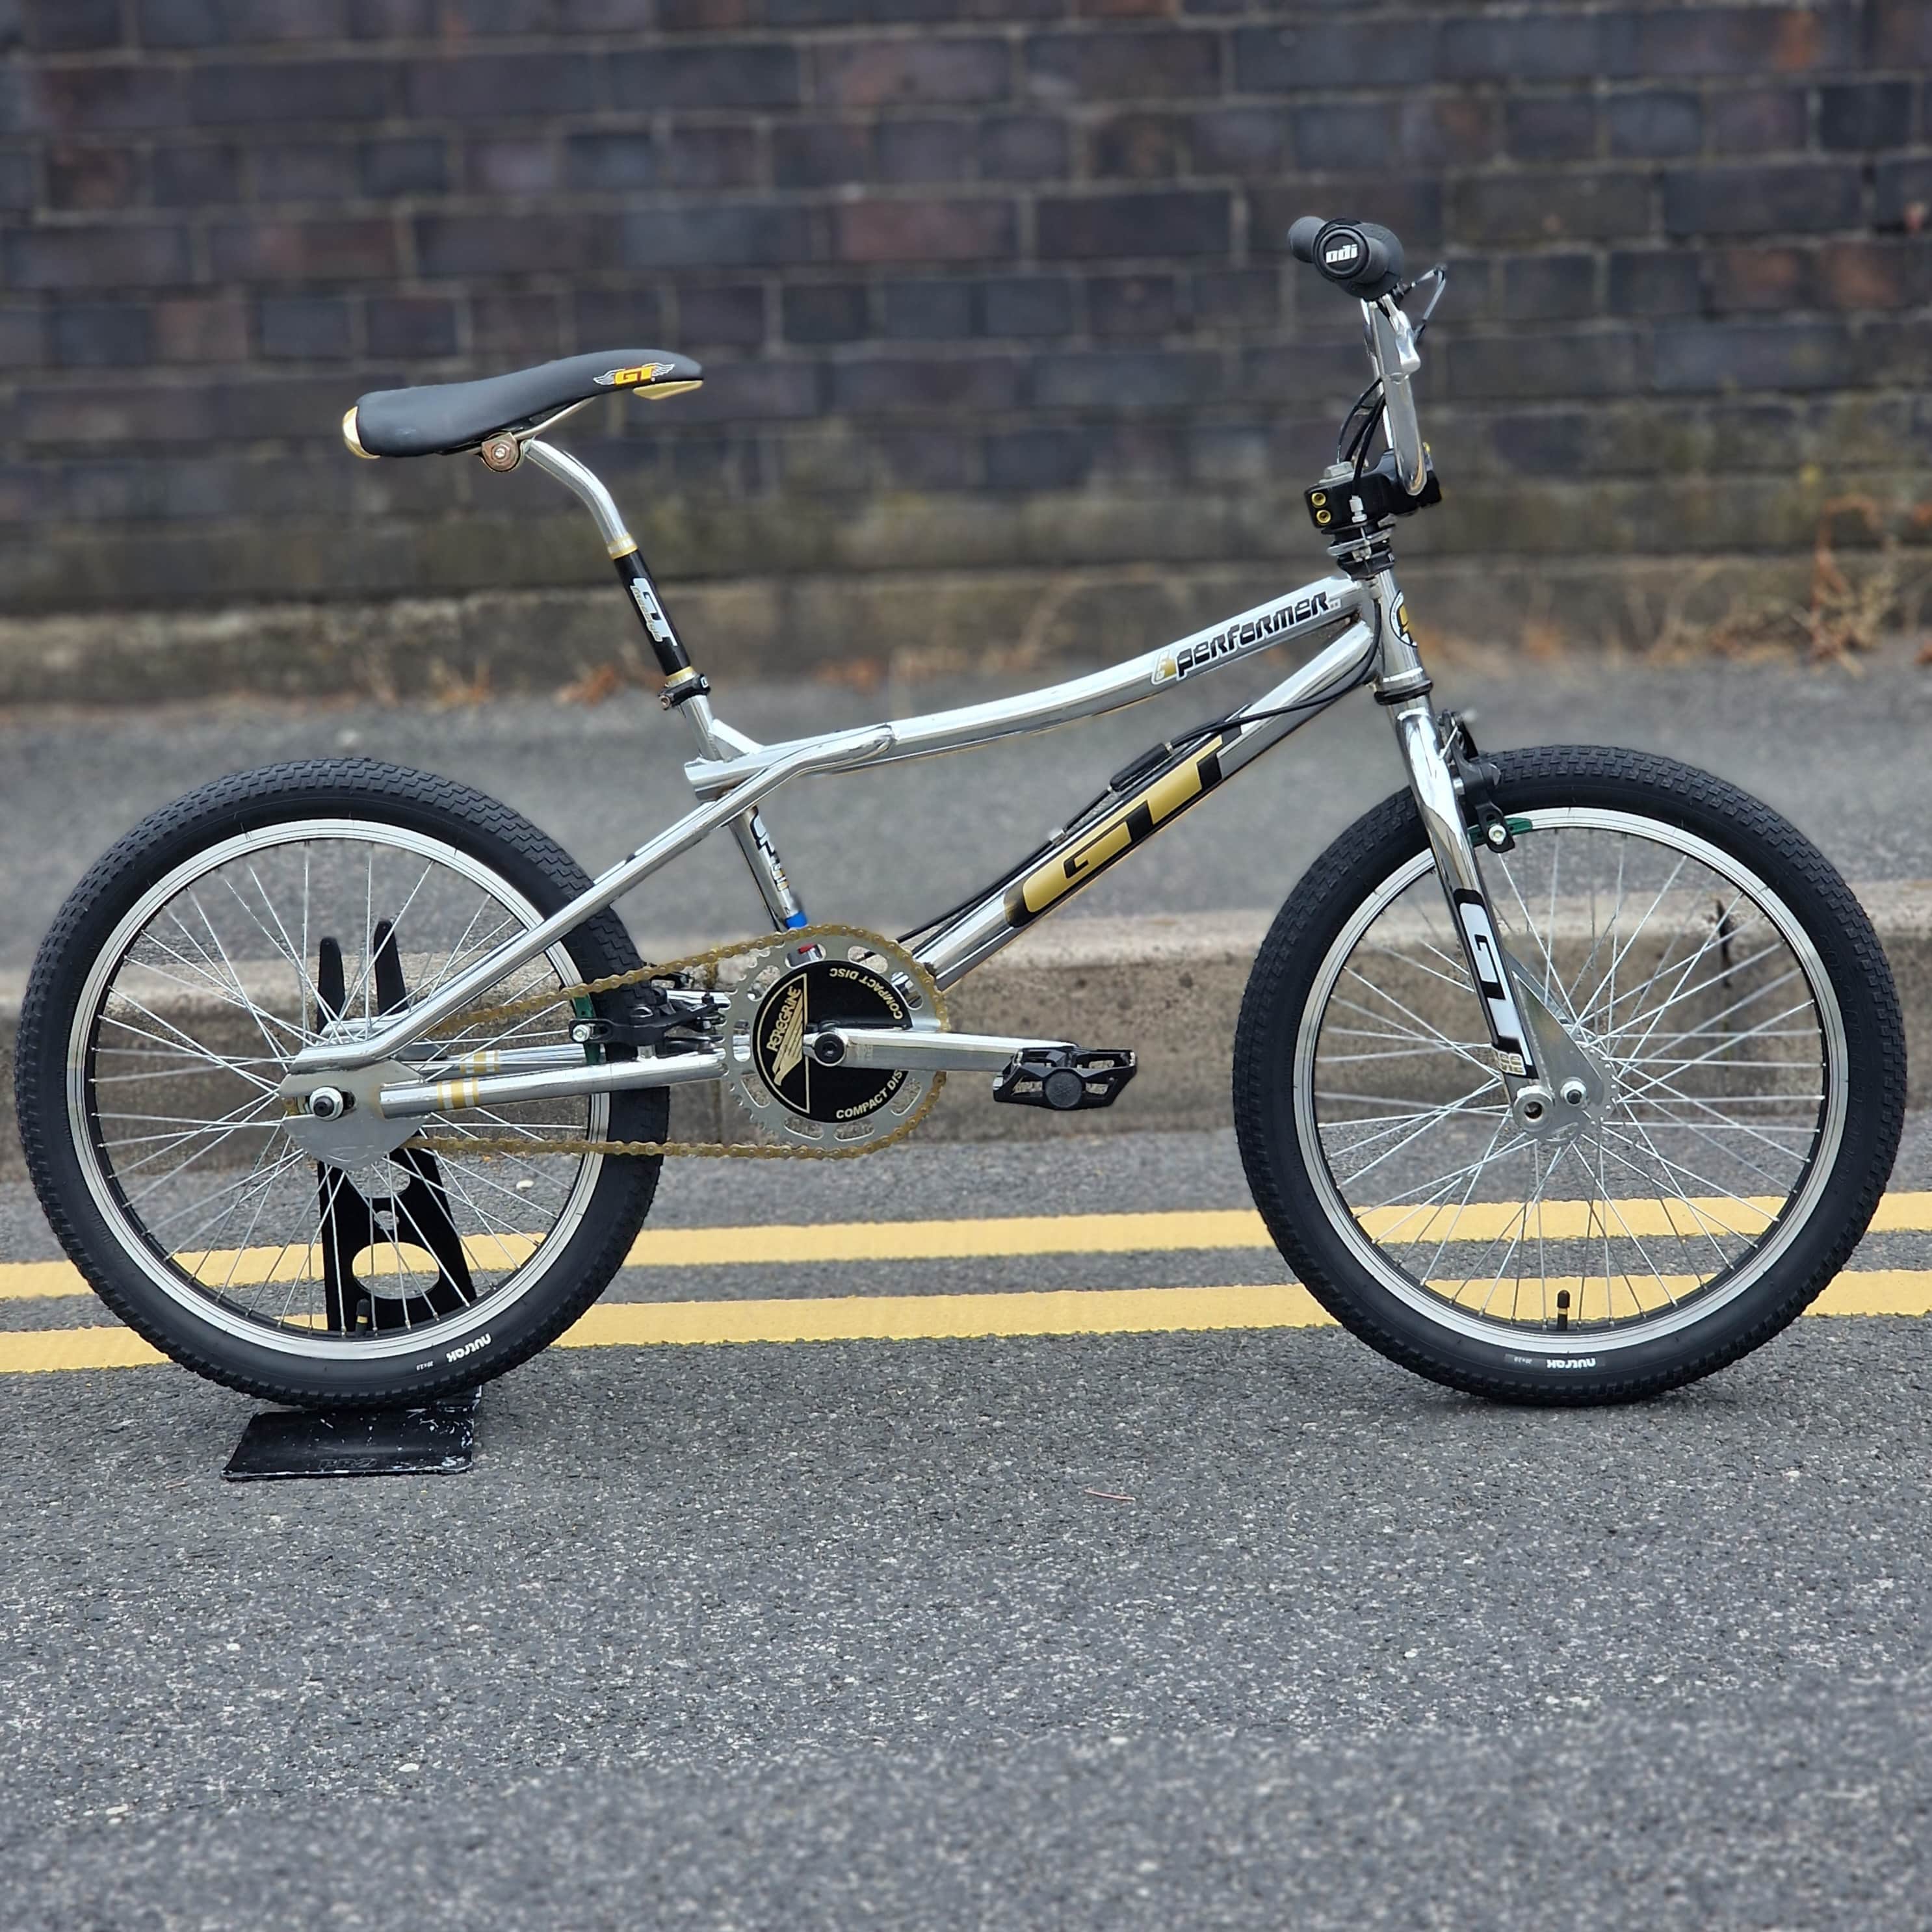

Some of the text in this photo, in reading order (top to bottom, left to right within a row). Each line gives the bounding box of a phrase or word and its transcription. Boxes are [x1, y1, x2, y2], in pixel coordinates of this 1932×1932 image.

[1325, 244, 1358, 263] odi
[614, 366, 657, 385] GT
[633, 578, 678, 647] GT
[1023, 735, 1223, 913] GT
[829, 967, 904, 1020] COMPACT DISC
[1459, 902, 1533, 1066] GT
[766, 985, 802, 1052] PEREGRINE
[835, 1069, 903, 1120] COMPACT DIS
[445, 1333, 492, 1363] nutrak
[1546, 1357, 1597, 1369] nutrak
